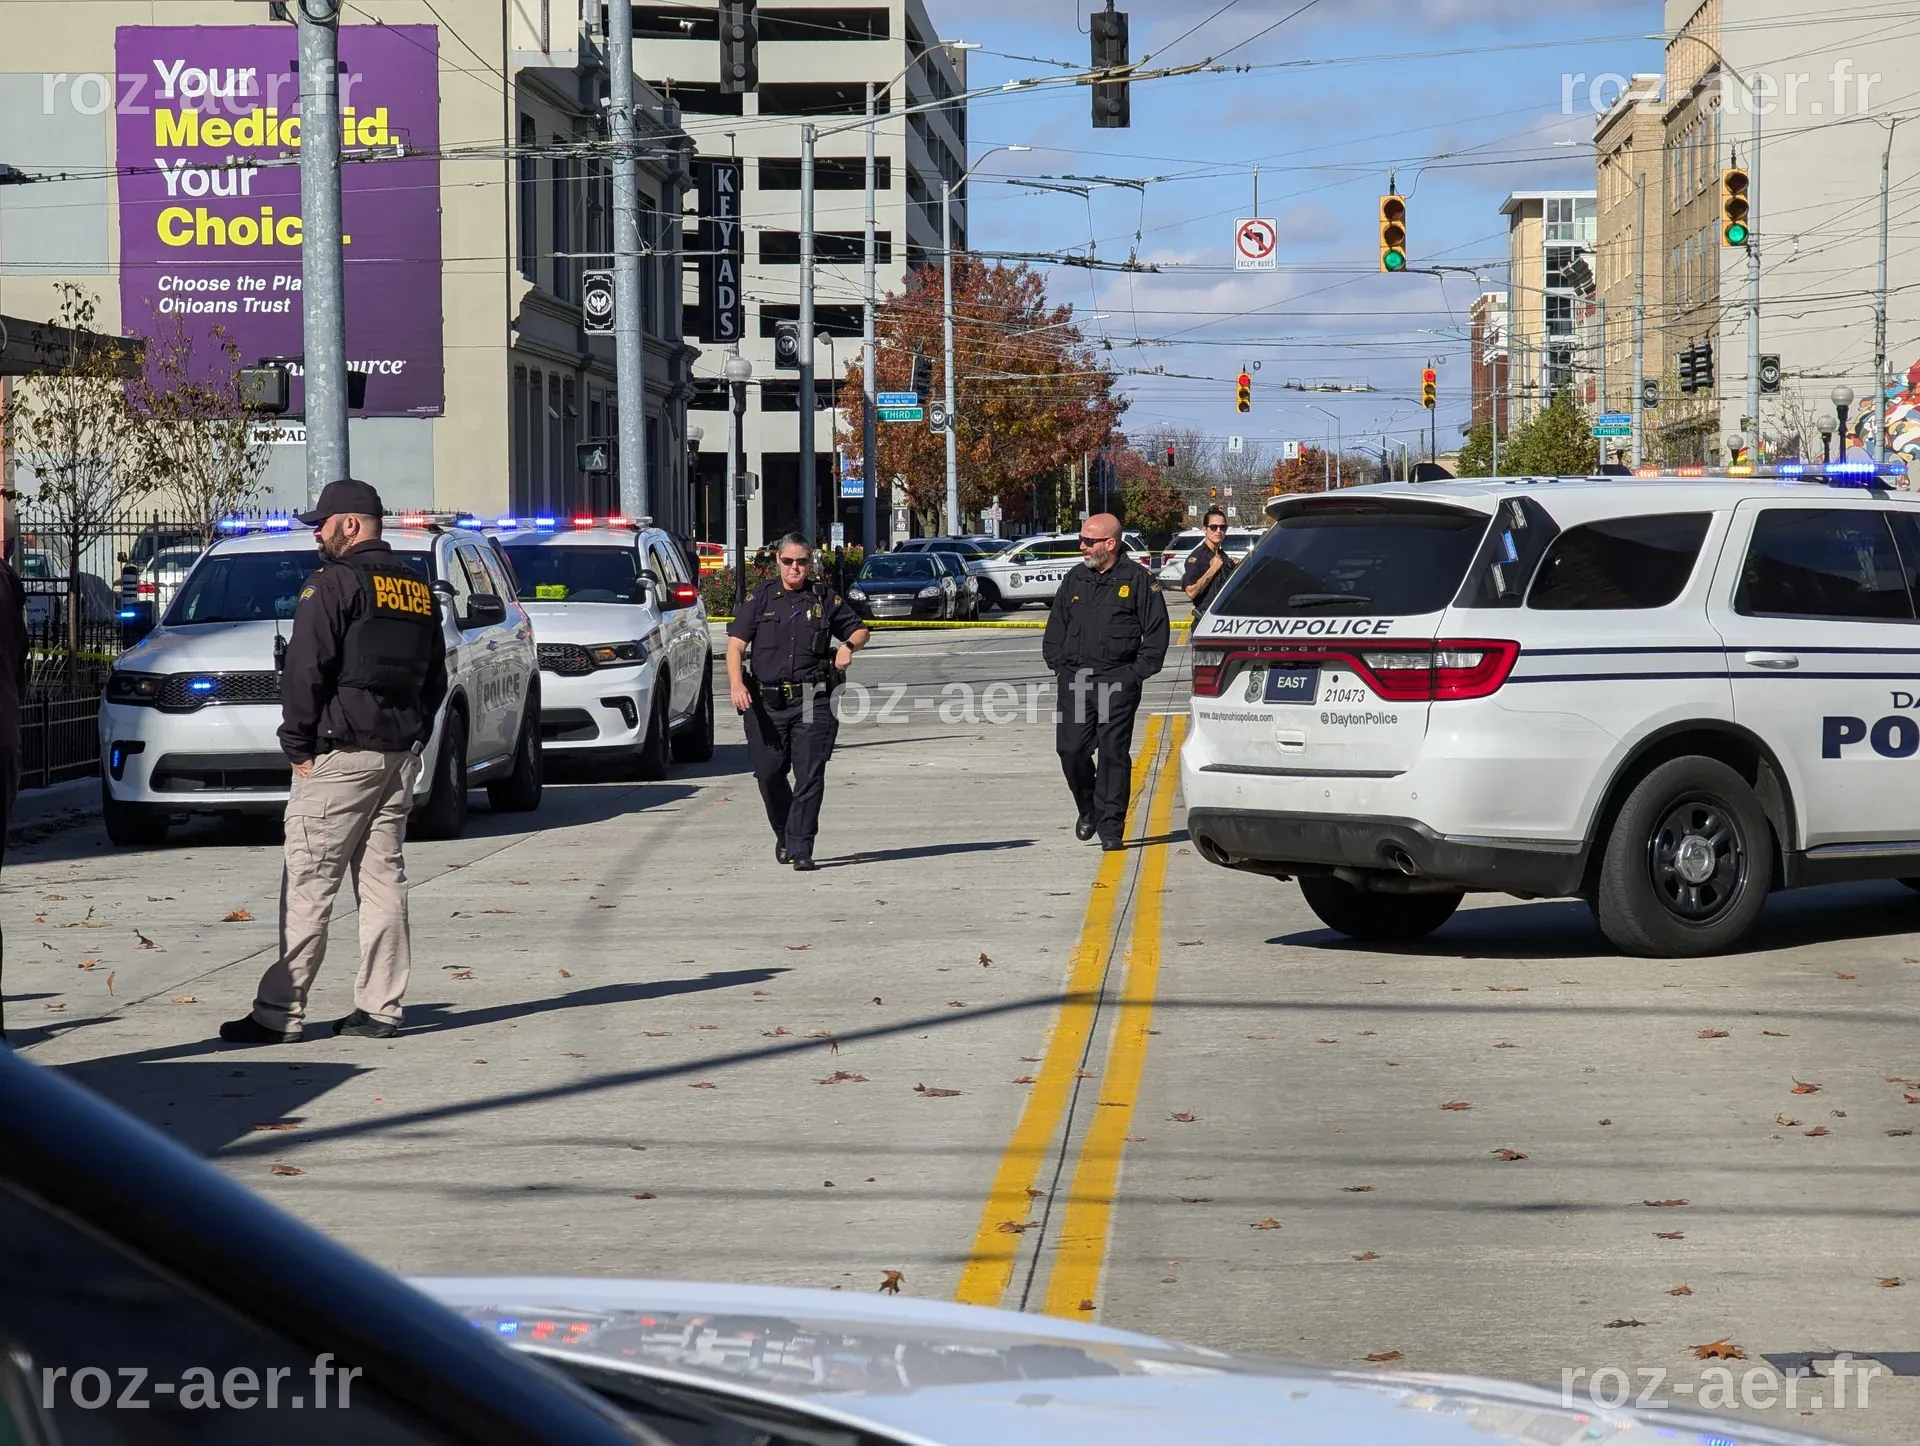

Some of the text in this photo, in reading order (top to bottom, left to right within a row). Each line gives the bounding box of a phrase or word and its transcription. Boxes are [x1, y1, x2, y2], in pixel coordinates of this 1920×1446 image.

[153, 59, 256, 97] Your
[155, 106, 400, 147] Medicid.
[154, 158, 257, 197] Your
[157, 206, 351, 247] Choic.
[158, 275, 304, 291] Choose the Pla
[159, 297, 291, 313] Ohioans Trust
[884, 410, 910, 419] THIRD
[373, 575, 431, 599] DAYTON
[376, 591, 432, 616] POLICE
[1277, 676, 1307, 688] EAST
[1324, 689, 1366, 703] 210473
[1199, 711, 1274, 724] www.daytonohiopolice.com
[1320, 712, 1398, 727] @DaytonPolice
[1822, 715, 1920, 759] PO
